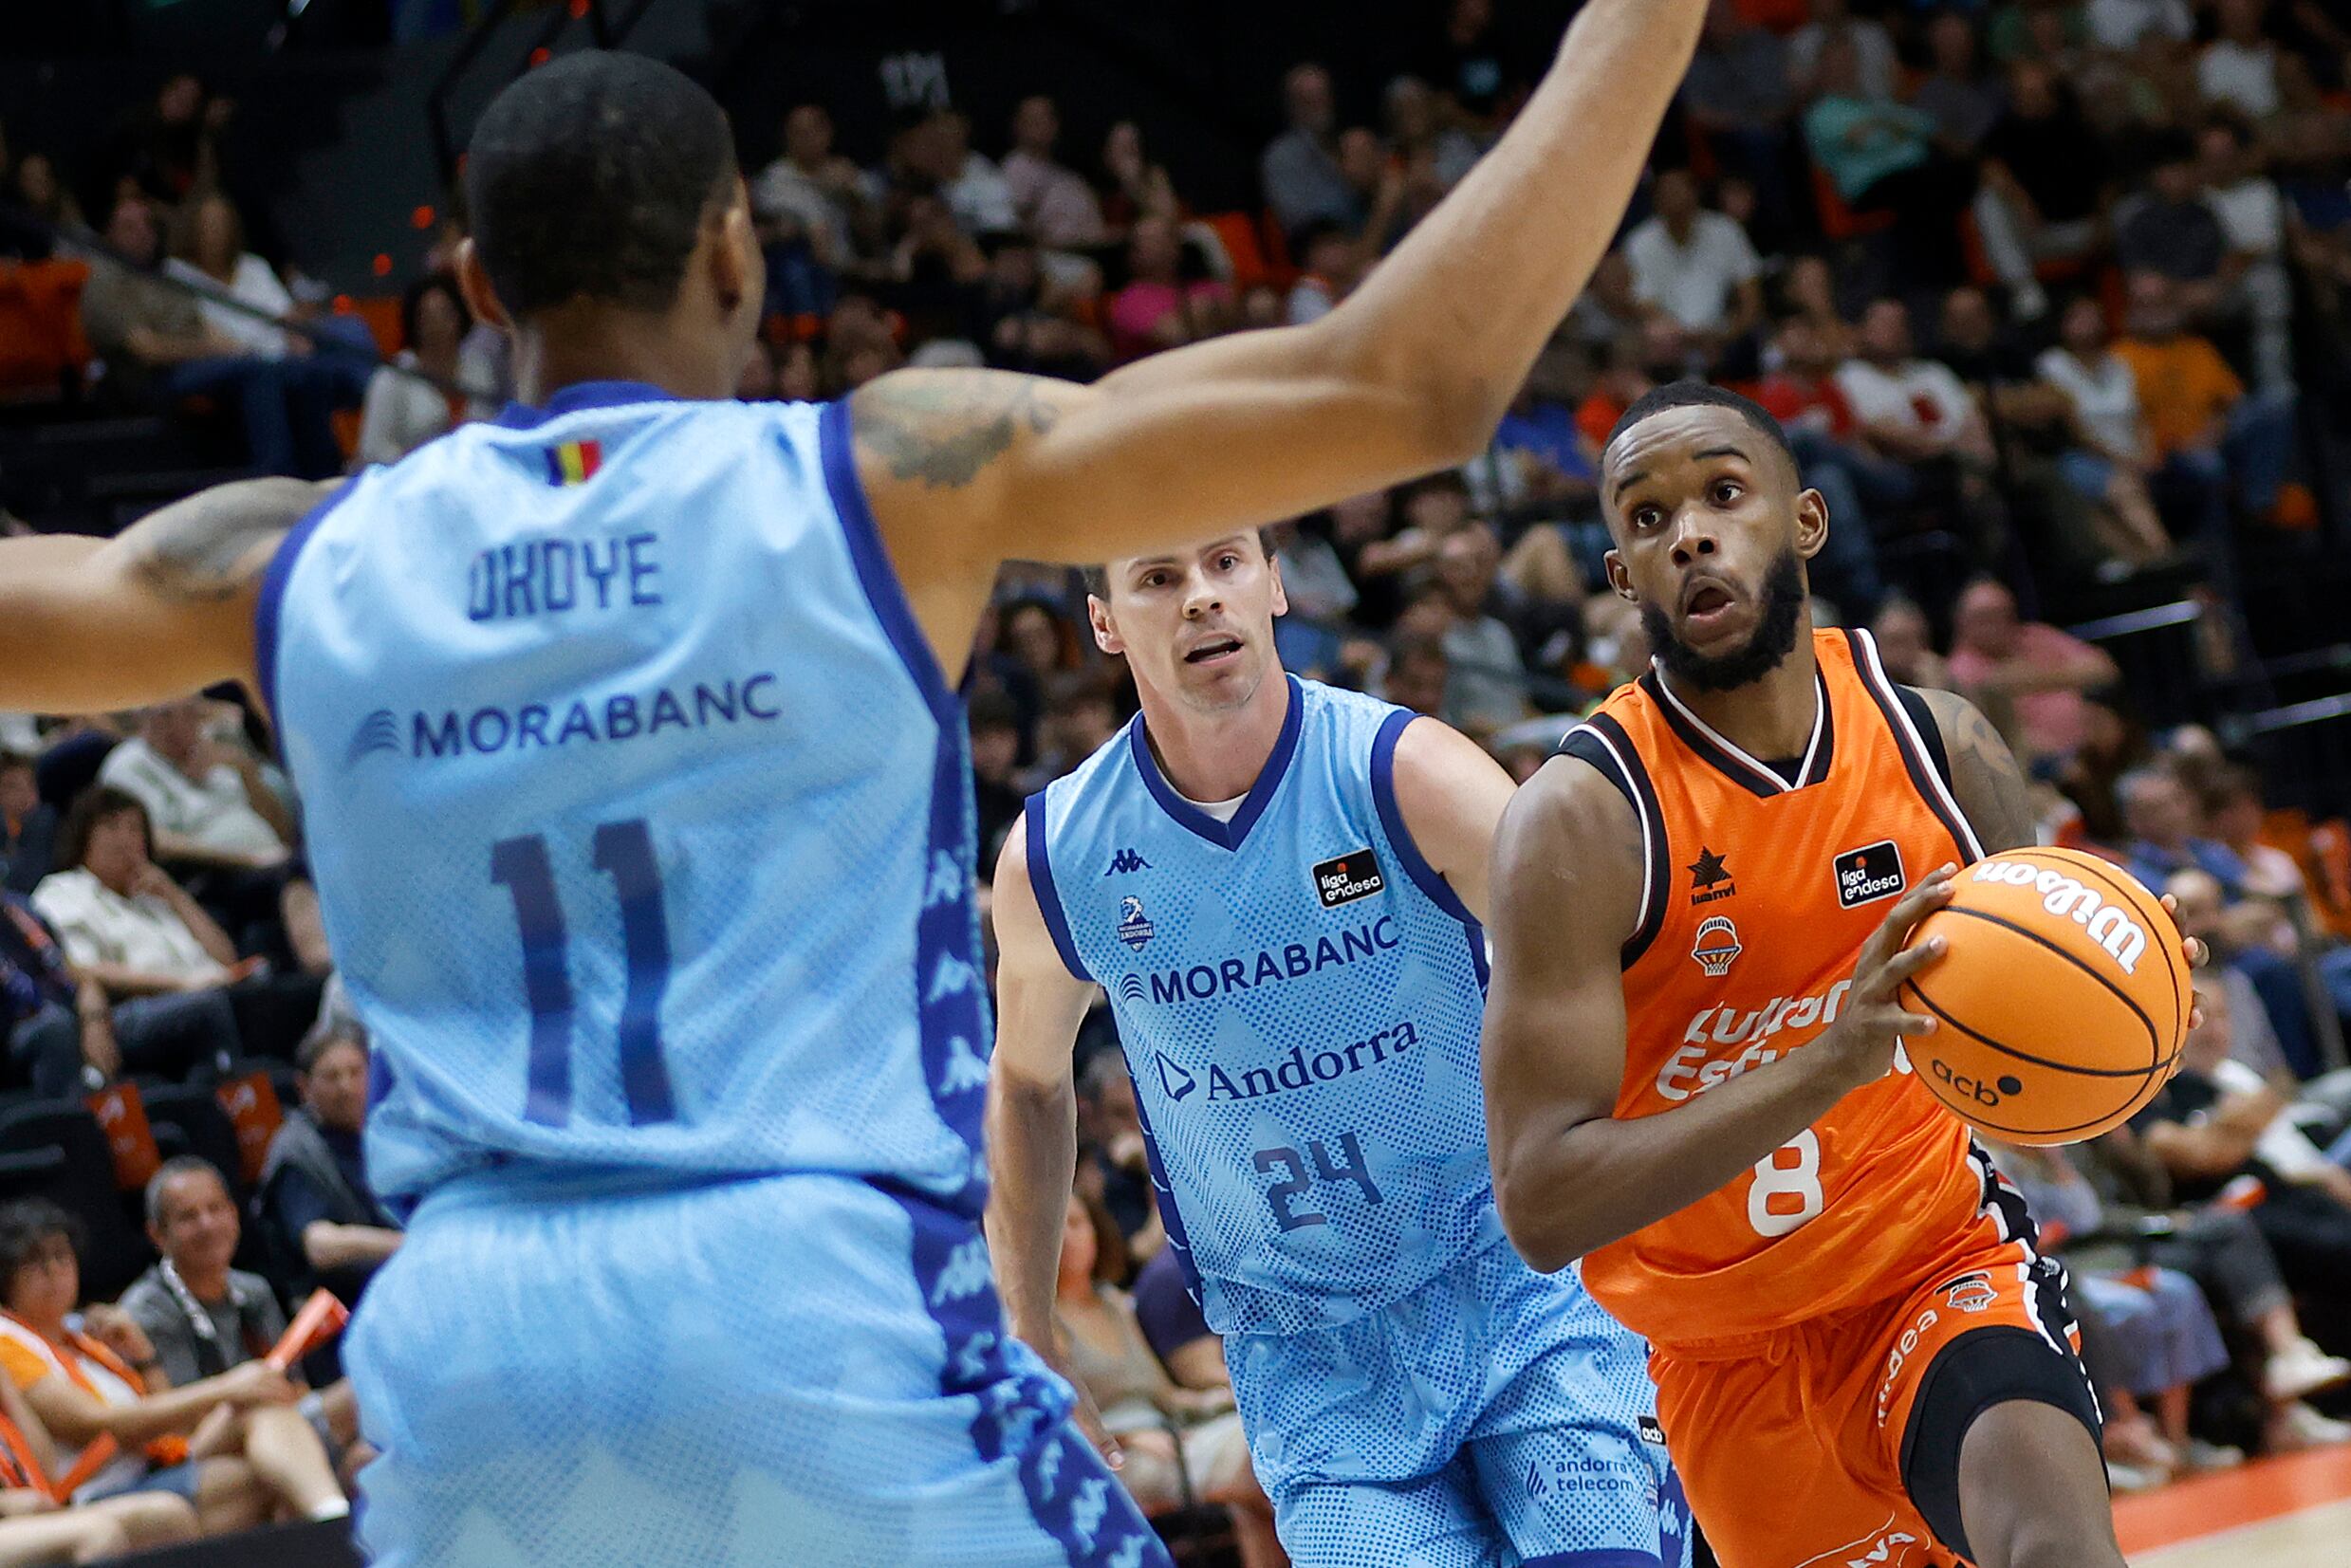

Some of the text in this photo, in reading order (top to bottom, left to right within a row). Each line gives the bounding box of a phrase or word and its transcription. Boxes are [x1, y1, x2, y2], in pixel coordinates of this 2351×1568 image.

[469, 532, 662, 622] OKOYE
[412, 673, 782, 758] MORABANC
[1321, 873, 1348, 890] liga
[1325, 876, 1381, 901] endesa
[1842, 868, 1866, 886] liga
[1844, 874, 1899, 900] endesa
[1972, 861, 2147, 975] Wilson
[490, 817, 677, 1129] 11
[1151, 915, 1398, 1005] MORABANC
[1207, 1021, 1419, 1100] Andorra
[1932, 1059, 2000, 1107] acb
[1253, 1131, 1384, 1233] 24
[1748, 1127, 1823, 1237] 8
[1555, 1457, 1628, 1473] andorra
[1642, 1426, 1662, 1443] acb
[1556, 1475, 1634, 1492] telecom
